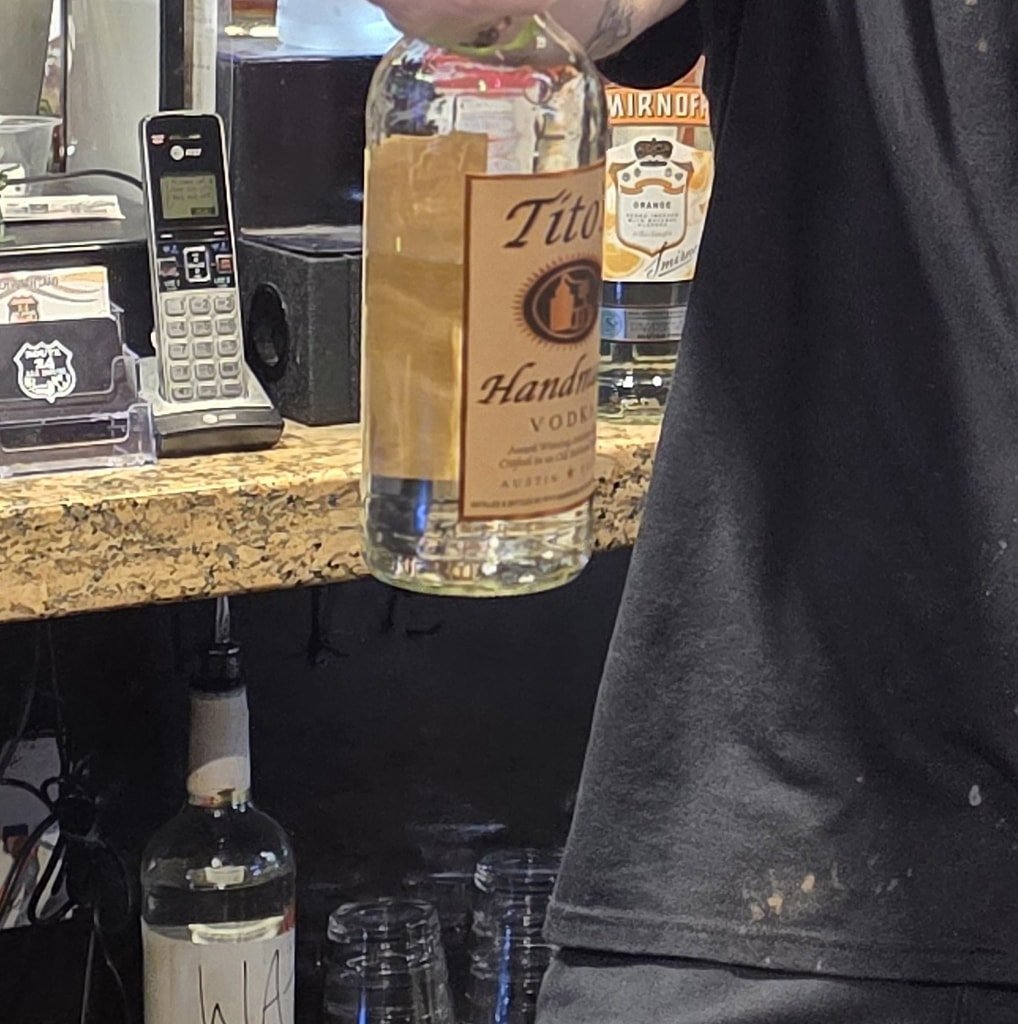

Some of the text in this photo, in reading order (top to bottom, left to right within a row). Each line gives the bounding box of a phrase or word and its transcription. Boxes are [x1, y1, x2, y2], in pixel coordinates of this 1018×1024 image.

[503, 188, 602, 248] Tito
[633, 201, 671, 210] ORANGE
[475, 352, 597, 406] Handm
